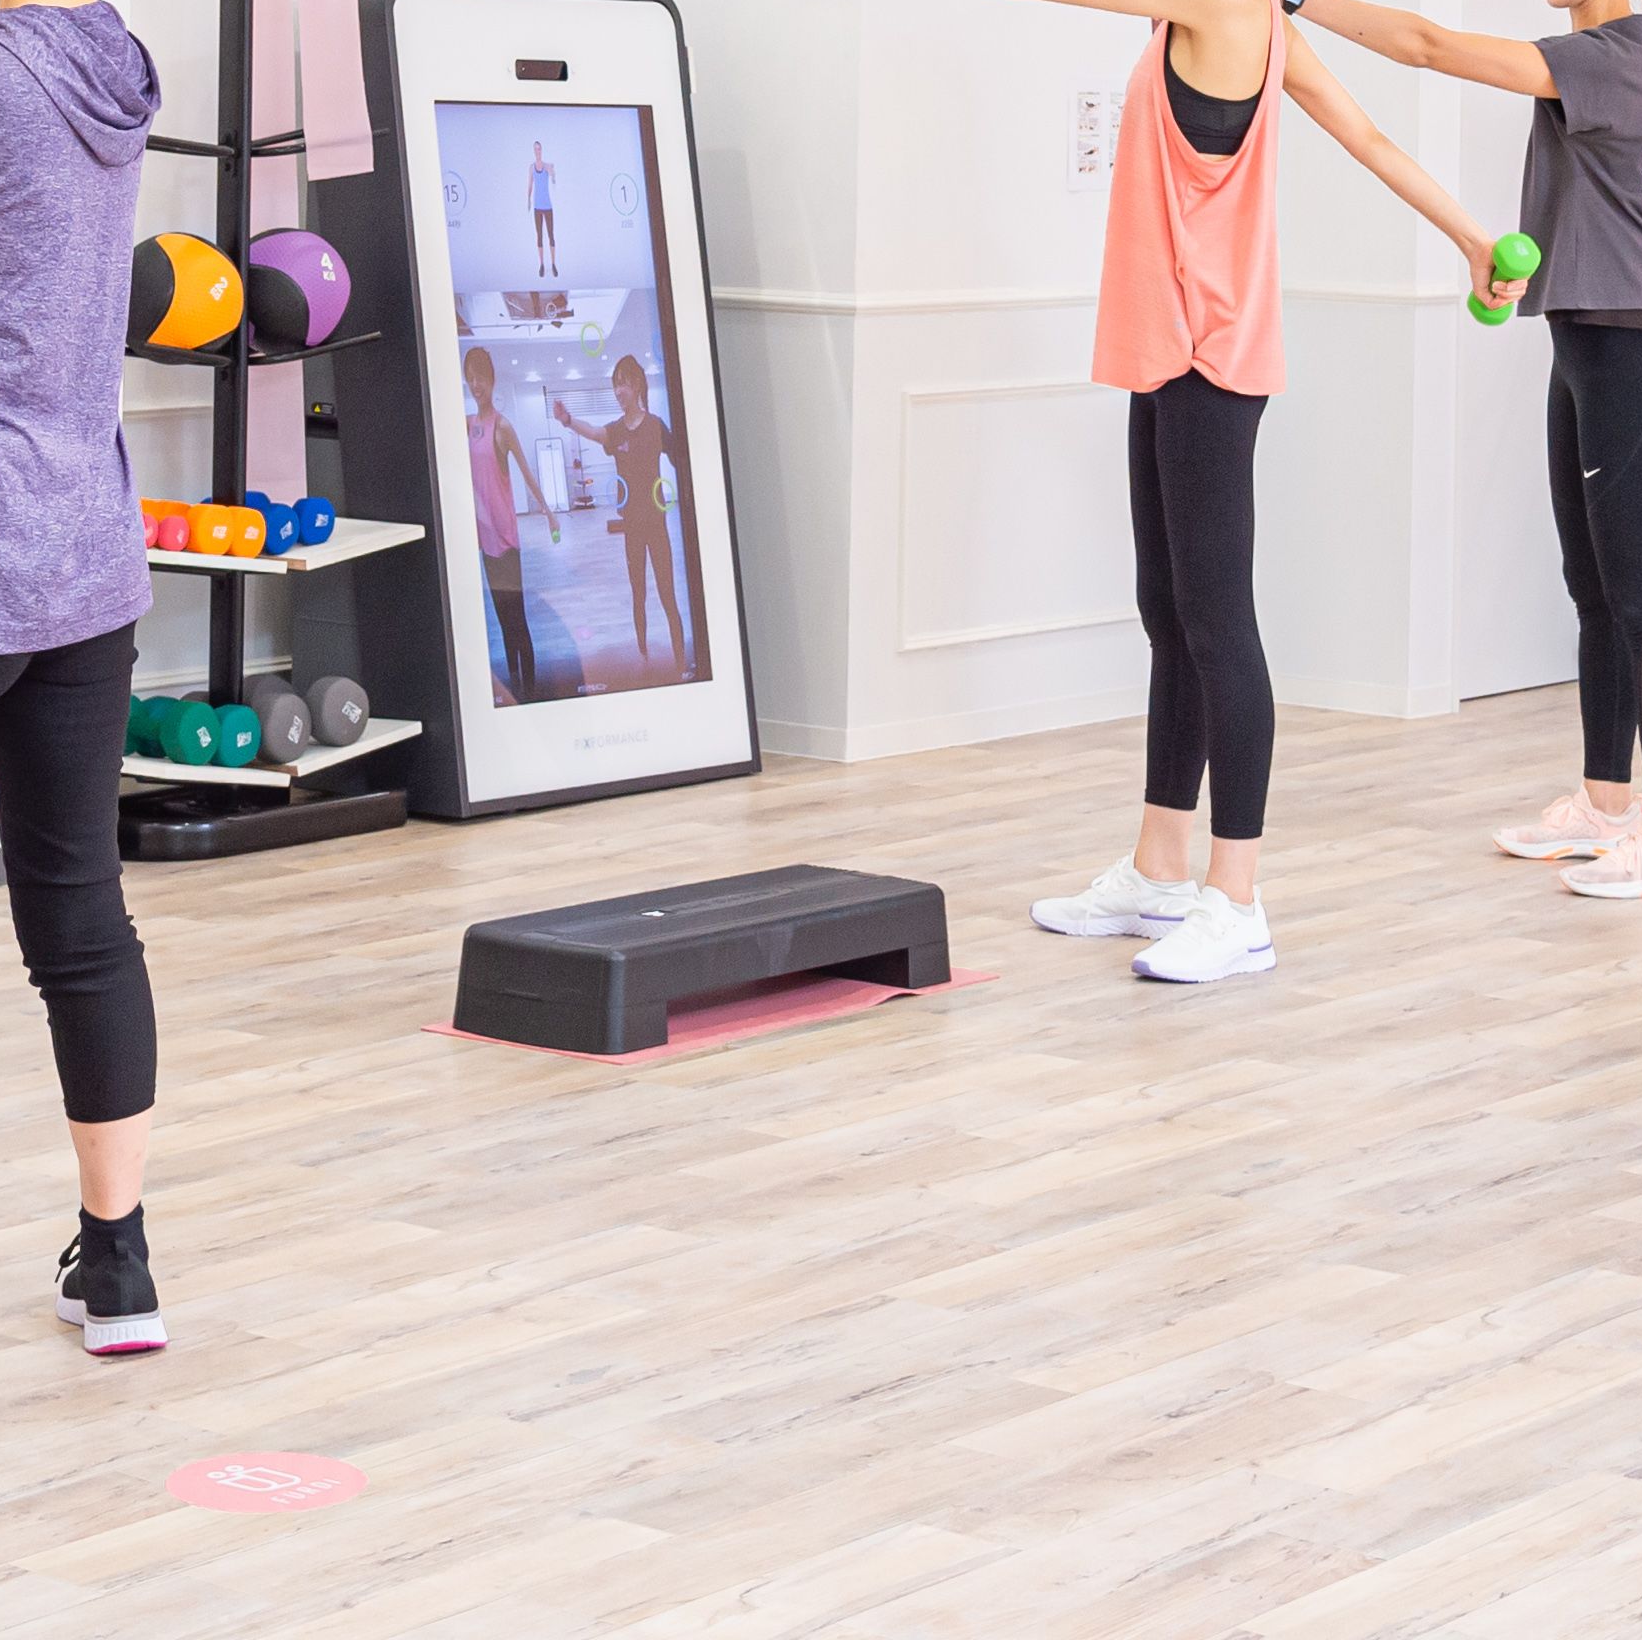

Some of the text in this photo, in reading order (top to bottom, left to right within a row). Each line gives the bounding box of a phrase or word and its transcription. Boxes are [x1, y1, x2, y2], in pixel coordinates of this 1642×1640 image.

[444, 184, 459, 203] 15
[620, 185, 628, 203] 1
[320, 252, 334, 271] 4
[270, 1477, 342, 1506] FURDI
